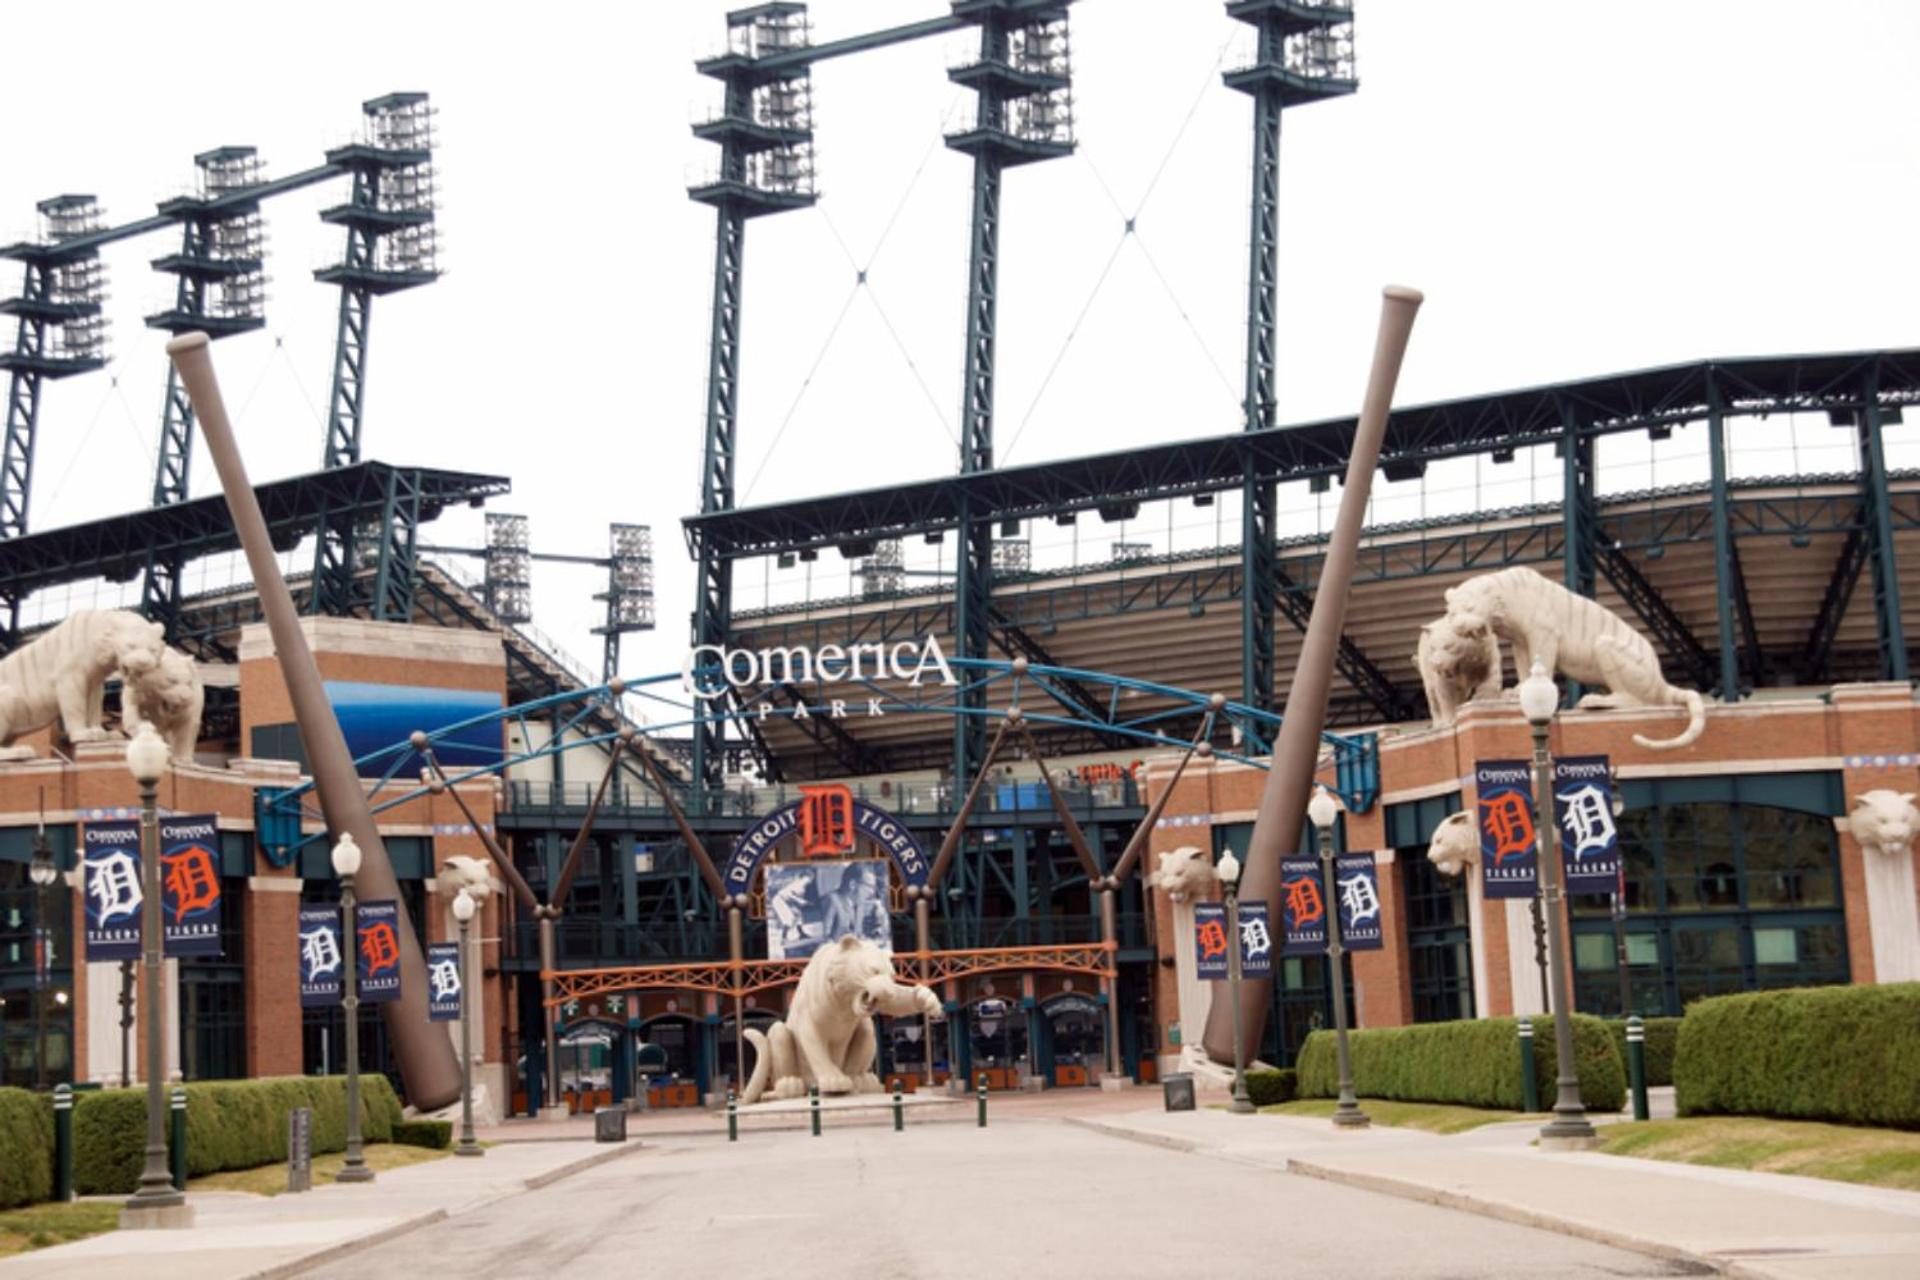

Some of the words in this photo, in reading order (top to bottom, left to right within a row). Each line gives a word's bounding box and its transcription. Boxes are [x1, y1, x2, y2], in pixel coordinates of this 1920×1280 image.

[759, 698, 884, 721] PARK
[730, 808, 798, 883] DETROIT
[859, 808, 923, 875] TIGERS
